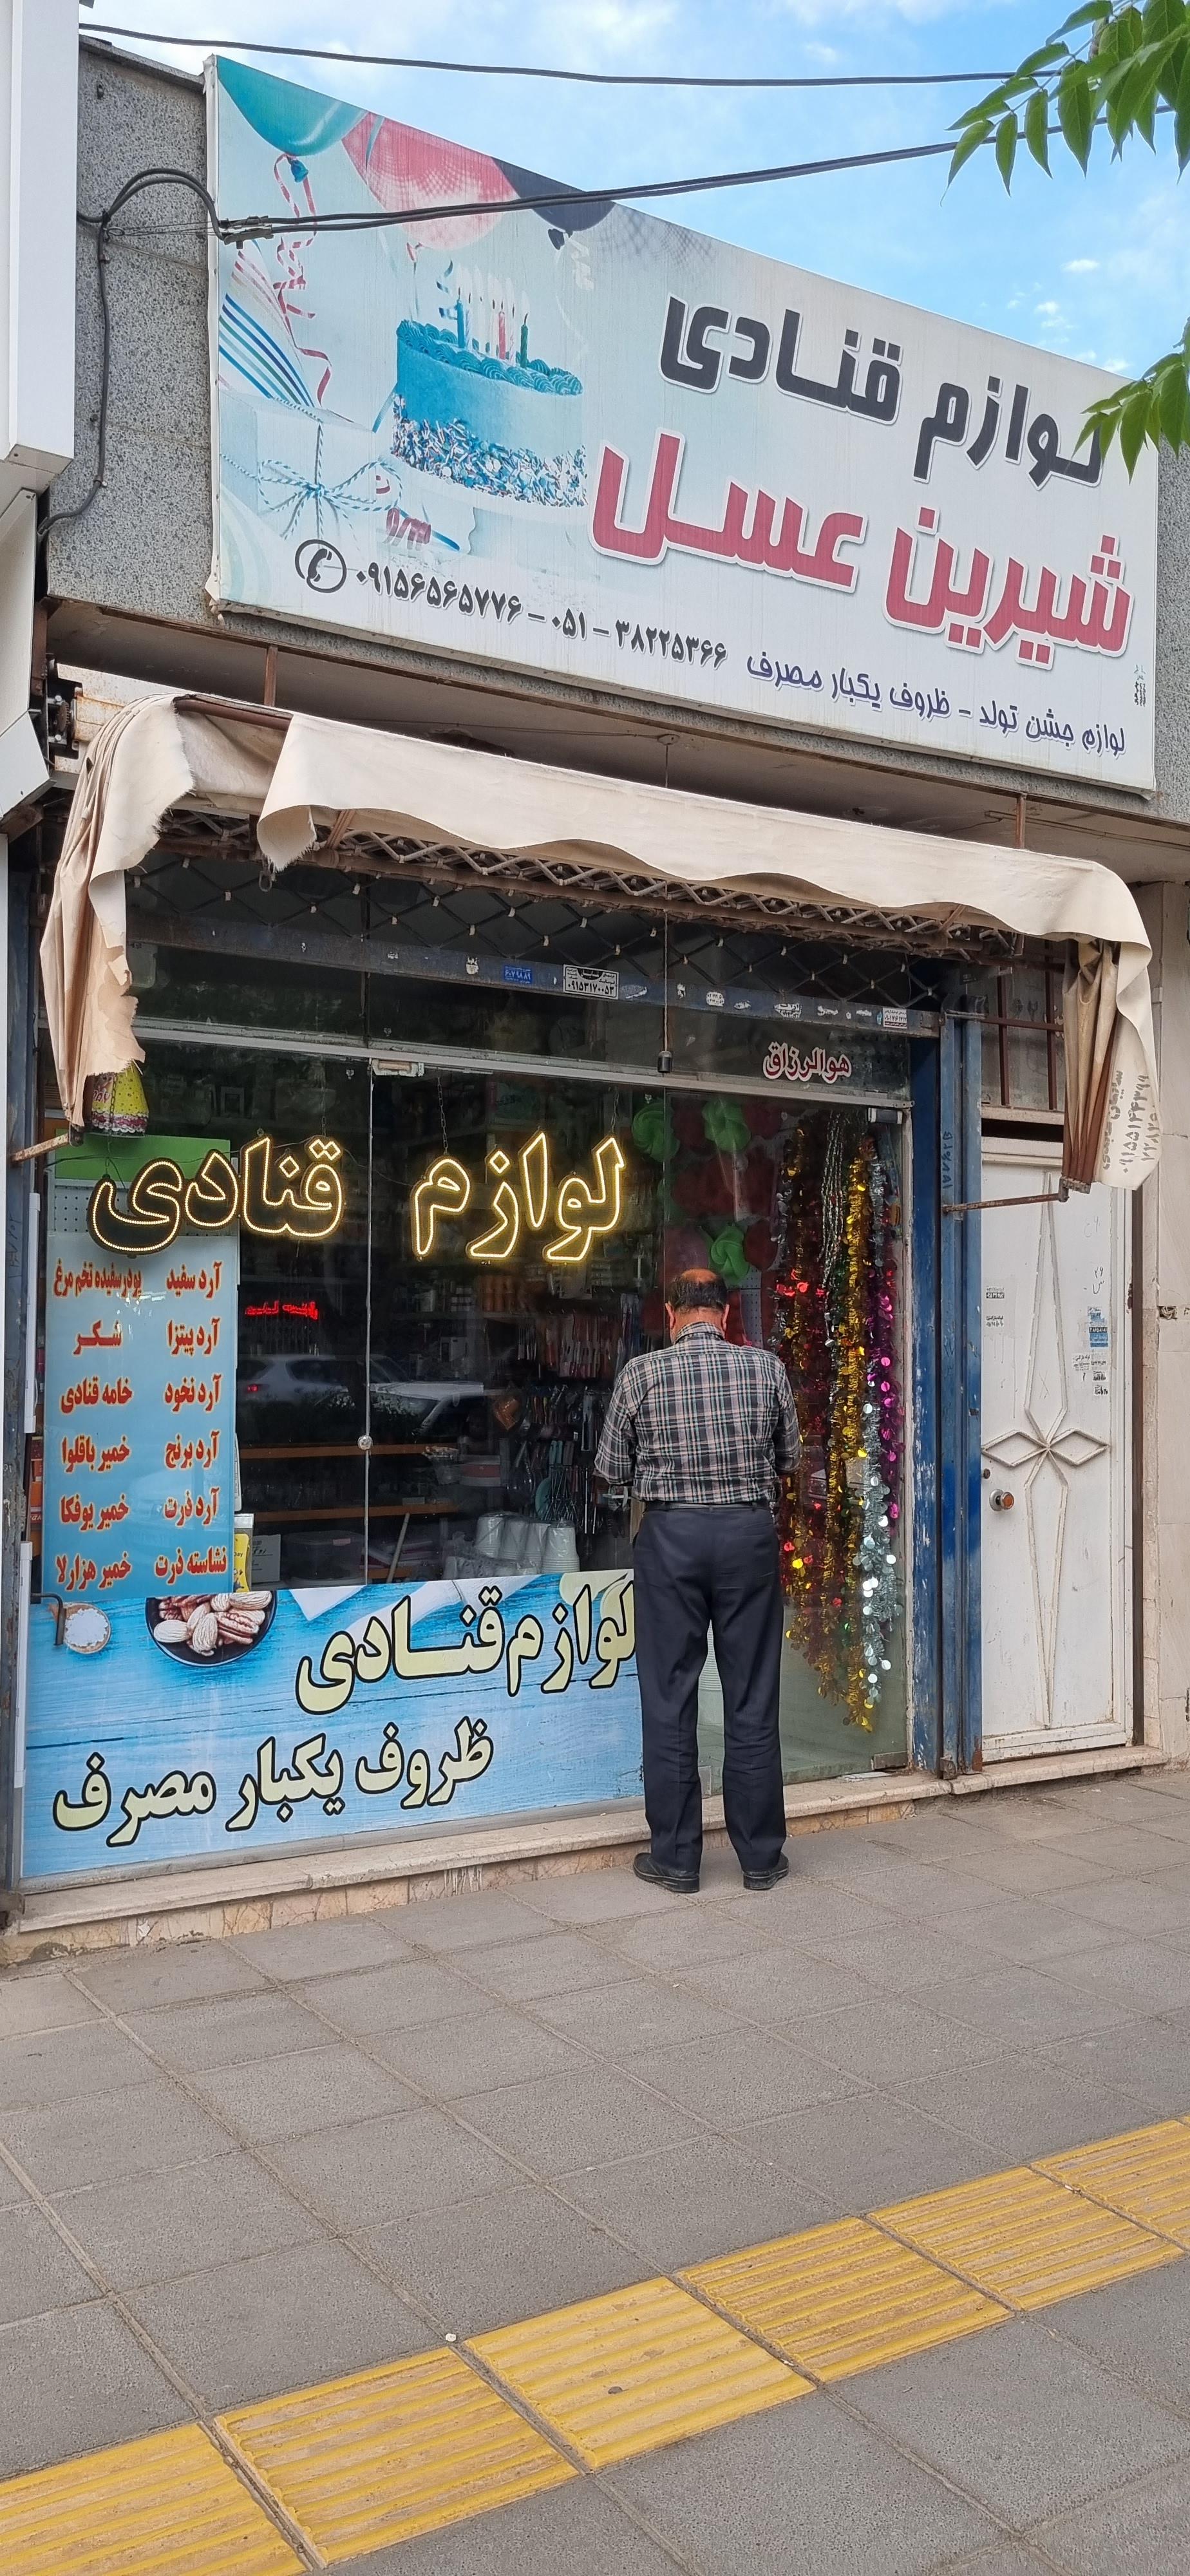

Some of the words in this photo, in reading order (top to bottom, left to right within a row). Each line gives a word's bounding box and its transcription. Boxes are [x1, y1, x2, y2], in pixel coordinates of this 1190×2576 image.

[661, 296, 901, 421] قنادی
[913, 375, 1102, 487] لوازم
[594, 435, 862, 585] عسل
[887, 508, 1130, 663] شیرین
[356, 562, 522, 622] ۰۹۱۵۶۵۶۵۷۷۶
[552, 607, 587, 639] ۰۵۱
[615, 620, 726, 668] ۳۸۲۲۵۳۶۶
[747, 651, 822, 687] مصرف
[831, 667, 880, 708] یکبار
[889, 683, 950, 718] ظروف
[979, 700, 1017, 734] تولد
[1026, 708, 1074, 746] جشن
[1082, 724, 1124, 756] لوازم
[764, 1042, 850, 1081] هوالرزاق
[87, 1135, 344, 1255] قنادی
[410, 1130, 625, 1262] لوازم
[53, 1258, 73, 1296] مرغ
[75, 1261, 93, 1297] تخم
[95, 1262, 122, 1295] سفیده
[121, 1267, 142, 1297] پودر
[166, 1264, 196, 1296] سفید
[198, 1262, 222, 1298] آرد
[73, 1320, 122, 1355] شکر
[167, 1320, 194, 1356] پیتزا
[196, 1318, 220, 1355] آرد
[61, 1376, 99, 1414] قنادی
[102, 1378, 133, 1405] خامه
[165, 1377, 195, 1412] نخود
[198, 1374, 222, 1412] آرد
[62, 1435, 95, 1472] باقلوا
[98, 1435, 130, 1471] خمیر
[165, 1434, 193, 1469] برنج
[196, 1430, 220, 1468] آرد
[60, 1494, 93, 1531] یوفکا
[97, 1494, 129, 1530] خمیر
[164, 1490, 193, 1526] ذرت
[196, 1487, 220, 1525] آرد
[56, 1555, 97, 1591] هزارلا
[99, 1551, 131, 1589] خمیر
[155, 1548, 184, 1584] ذرت
[187, 1547, 227, 1574] نشاسته
[296, 1584, 504, 1715] قنادی
[506, 1580, 636, 1696] لوازم
[355, 1715, 495, 1810] ظروف
[52, 1751, 216, 1848] مصرف
[225, 1732, 343, 1832] یکبار
